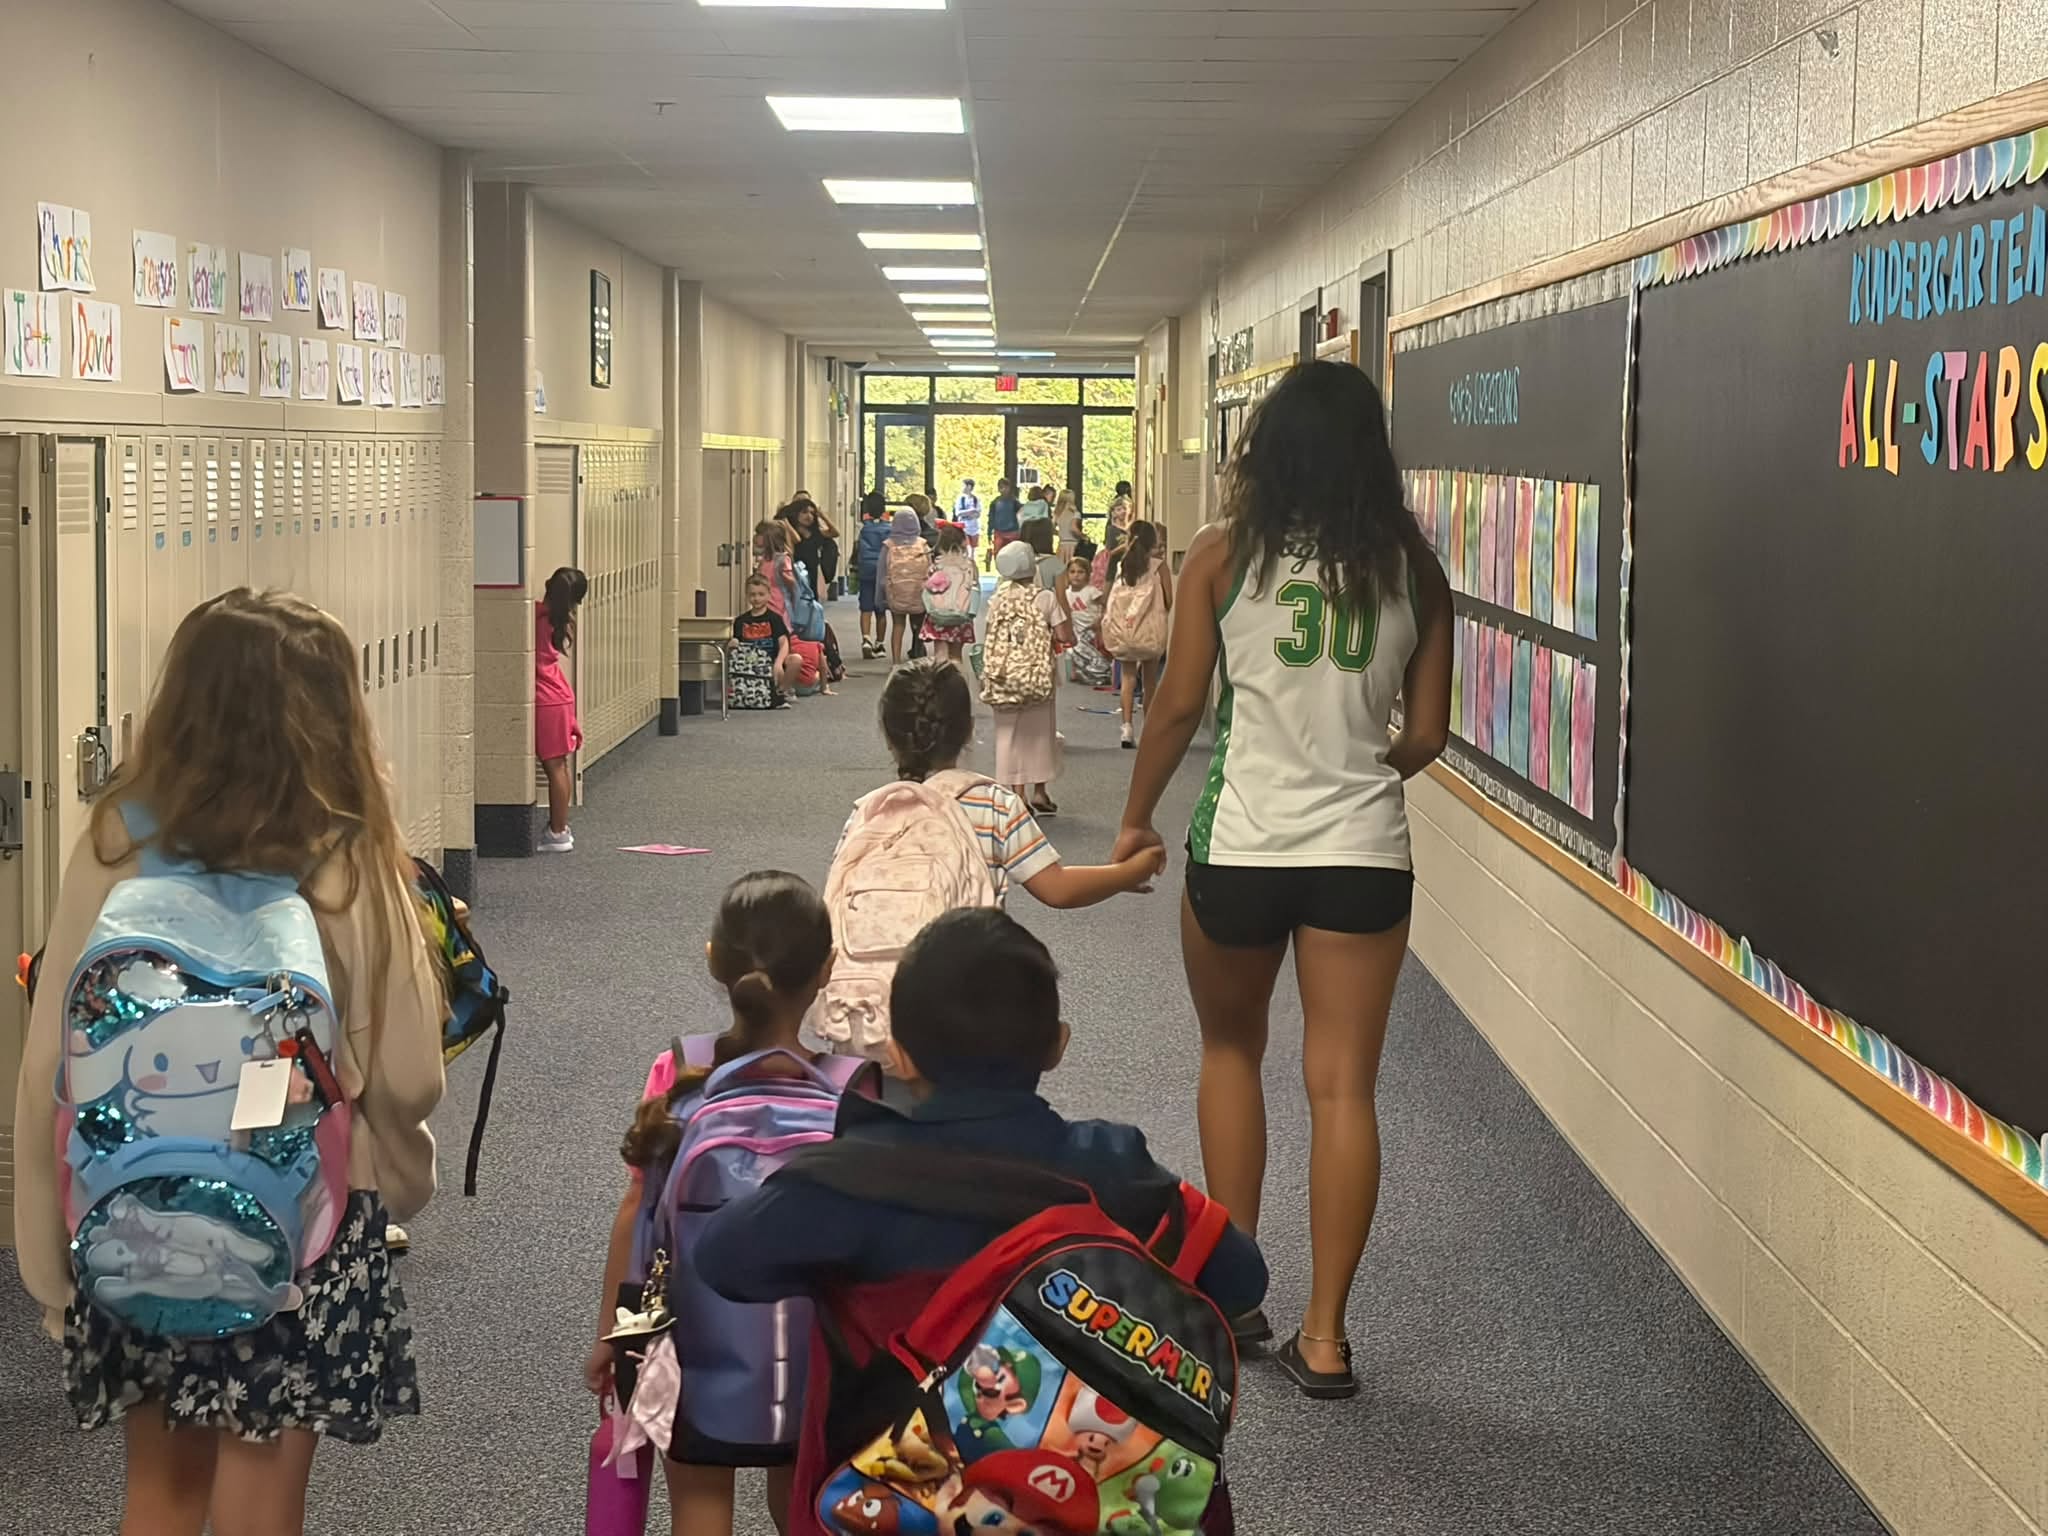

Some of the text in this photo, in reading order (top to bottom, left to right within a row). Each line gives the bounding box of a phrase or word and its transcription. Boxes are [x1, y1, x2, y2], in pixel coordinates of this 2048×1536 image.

[1848, 203, 2048, 326] KINDERGARTEN
[1838, 342, 2048, 477] ALL-STARS
[1274, 579, 1382, 673] 30
[1040, 1269, 1156, 1360] SUPER
